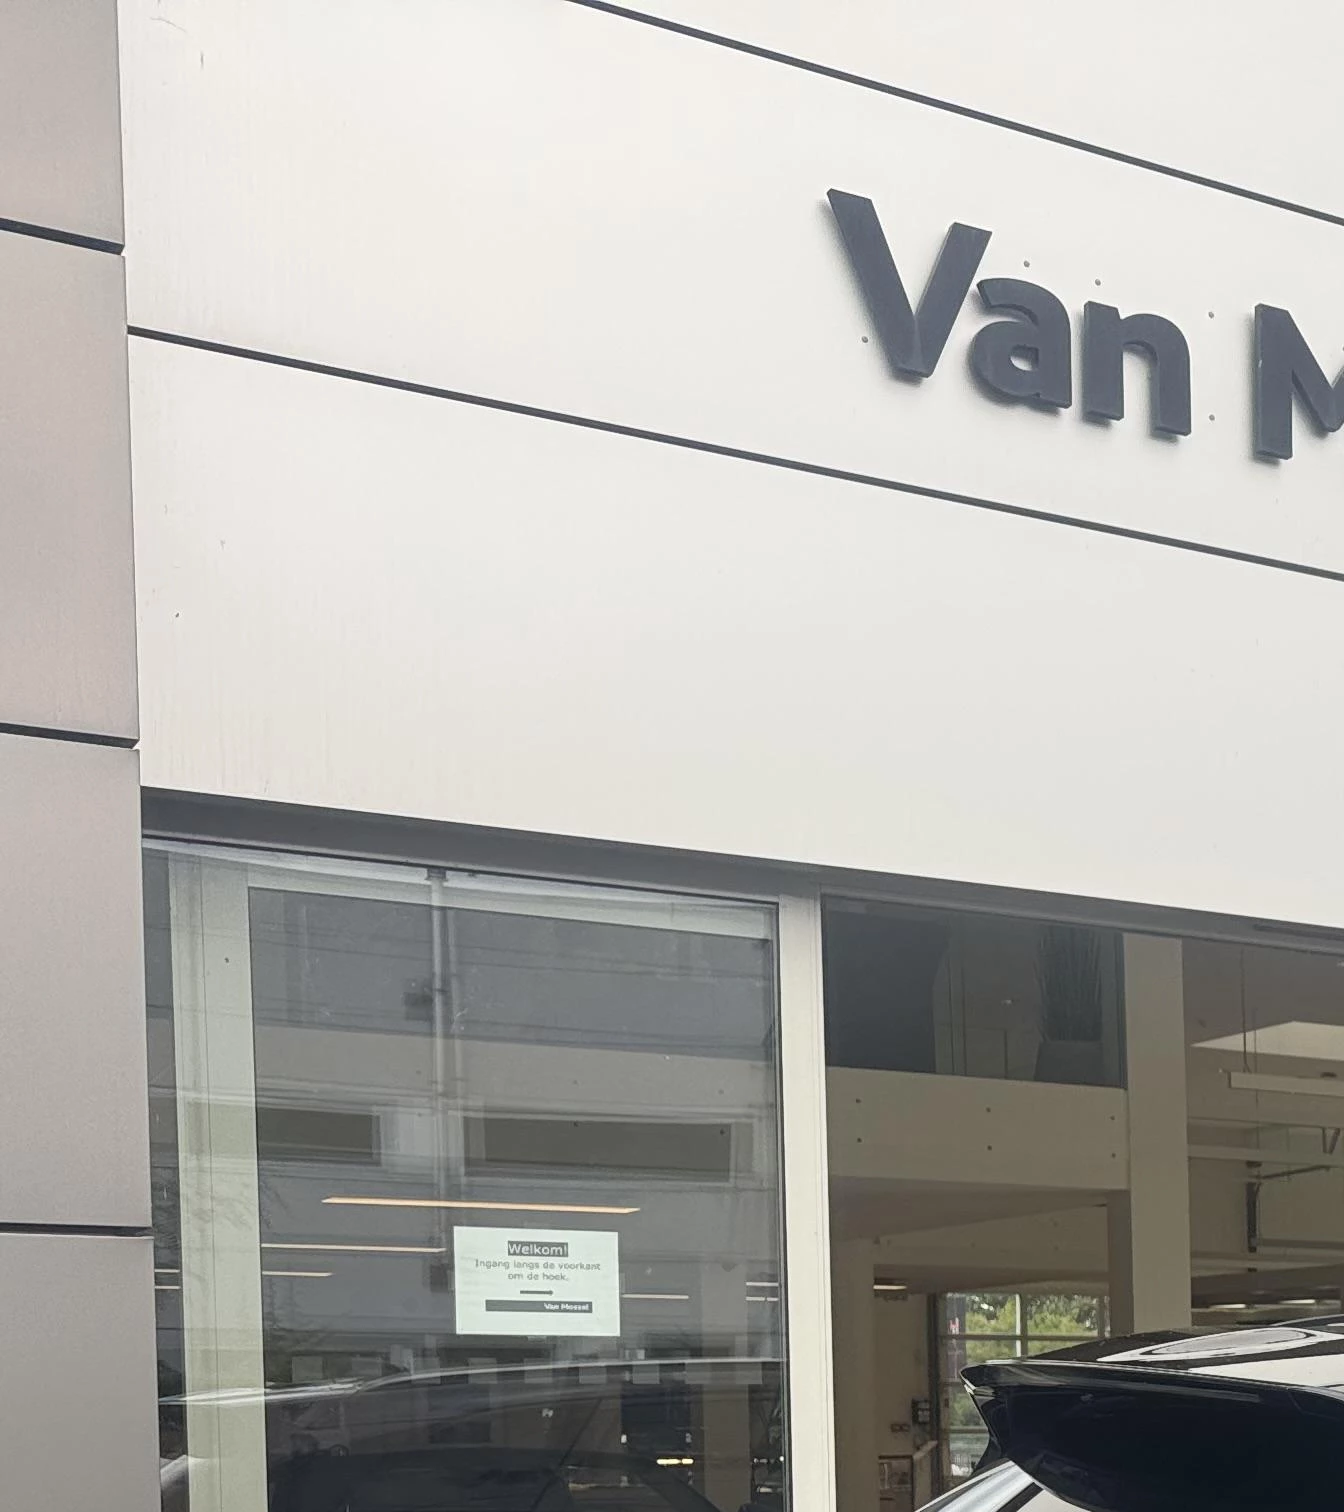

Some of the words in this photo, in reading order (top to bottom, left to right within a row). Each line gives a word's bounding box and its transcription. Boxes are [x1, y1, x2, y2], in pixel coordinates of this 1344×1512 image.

[826, 187, 1192, 440] Van
[508, 1242, 568, 1256] Welkom!
[475, 1258, 510, 1270] Ingang
[513, 1260, 540, 1270] langs
[543, 1260, 555, 1269] de
[558, 1262, 601, 1270] voorkant
[527, 1272, 539, 1281] de
